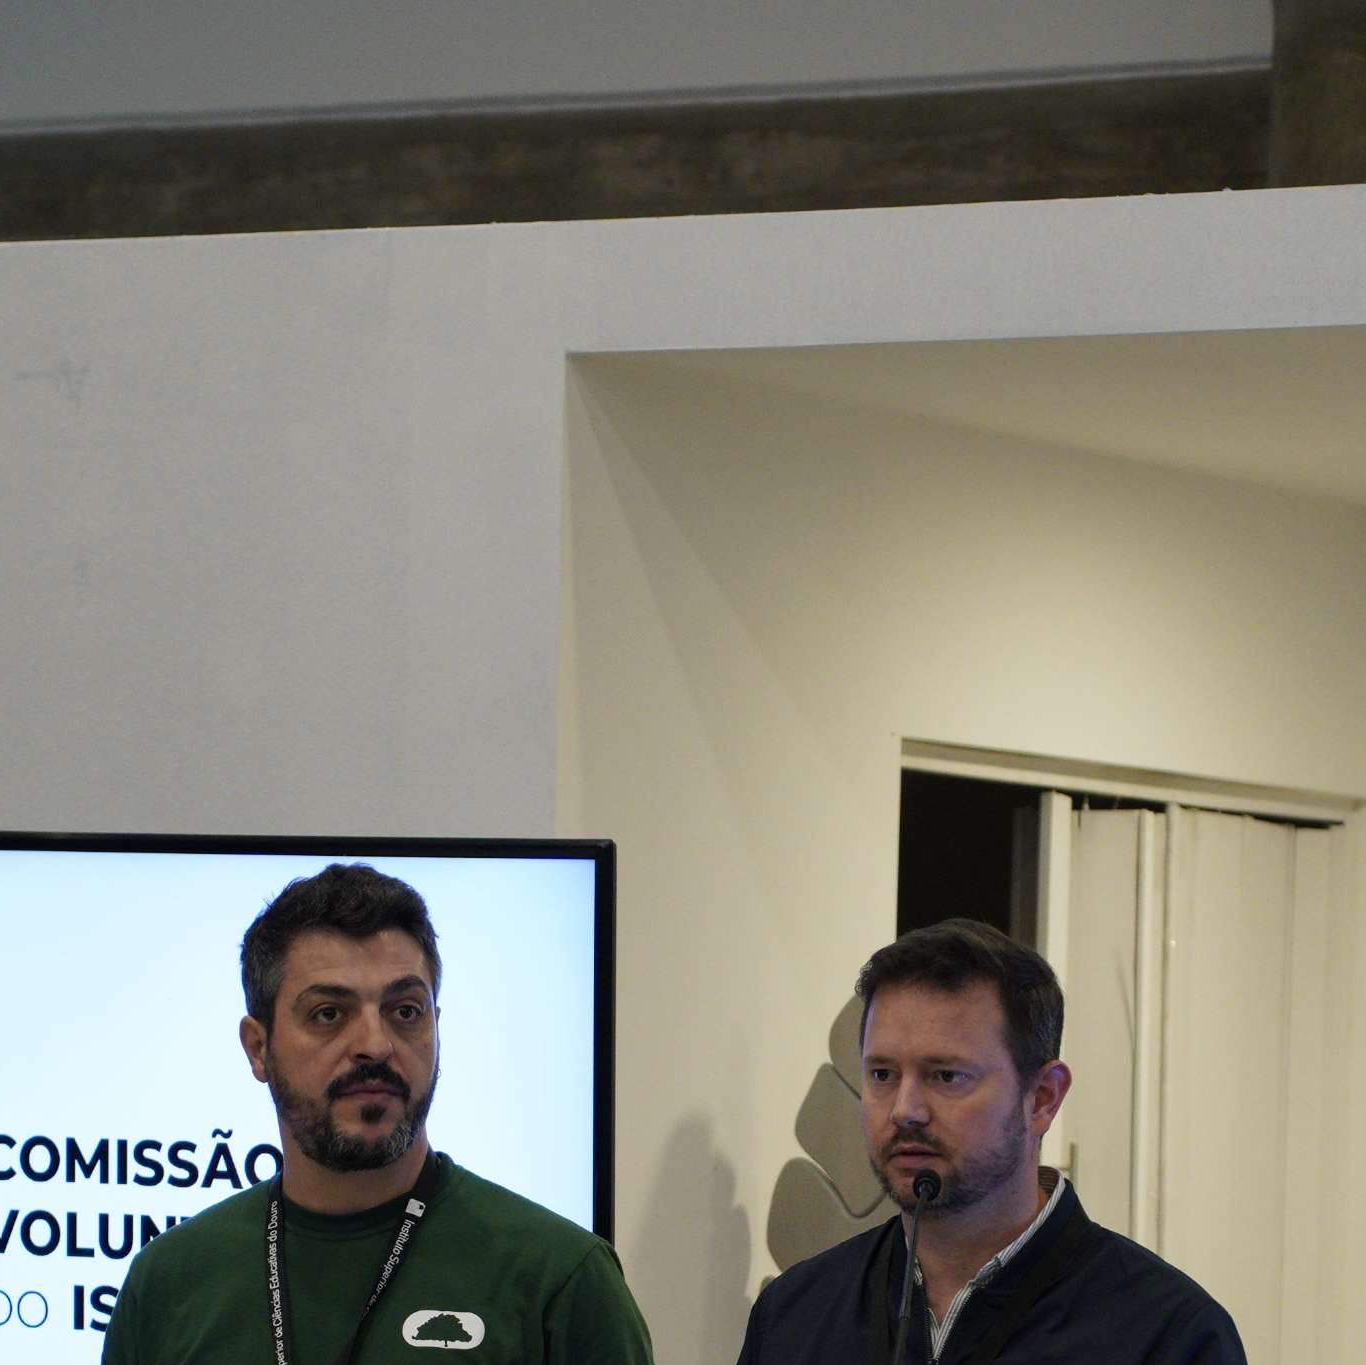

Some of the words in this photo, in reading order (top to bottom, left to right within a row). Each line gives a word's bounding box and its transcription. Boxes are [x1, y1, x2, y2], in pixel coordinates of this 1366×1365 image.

[268, 1200, 278, 1230] Douro
[268, 1231, 278, 1242] do
[392, 1219, 415, 1255] Instituto
[269, 1243, 280, 1289] Educativas
[376, 1254, 399, 1295] Superior
[272, 1289, 284, 1327] Ciências
[274, 1326, 284, 1338] de
